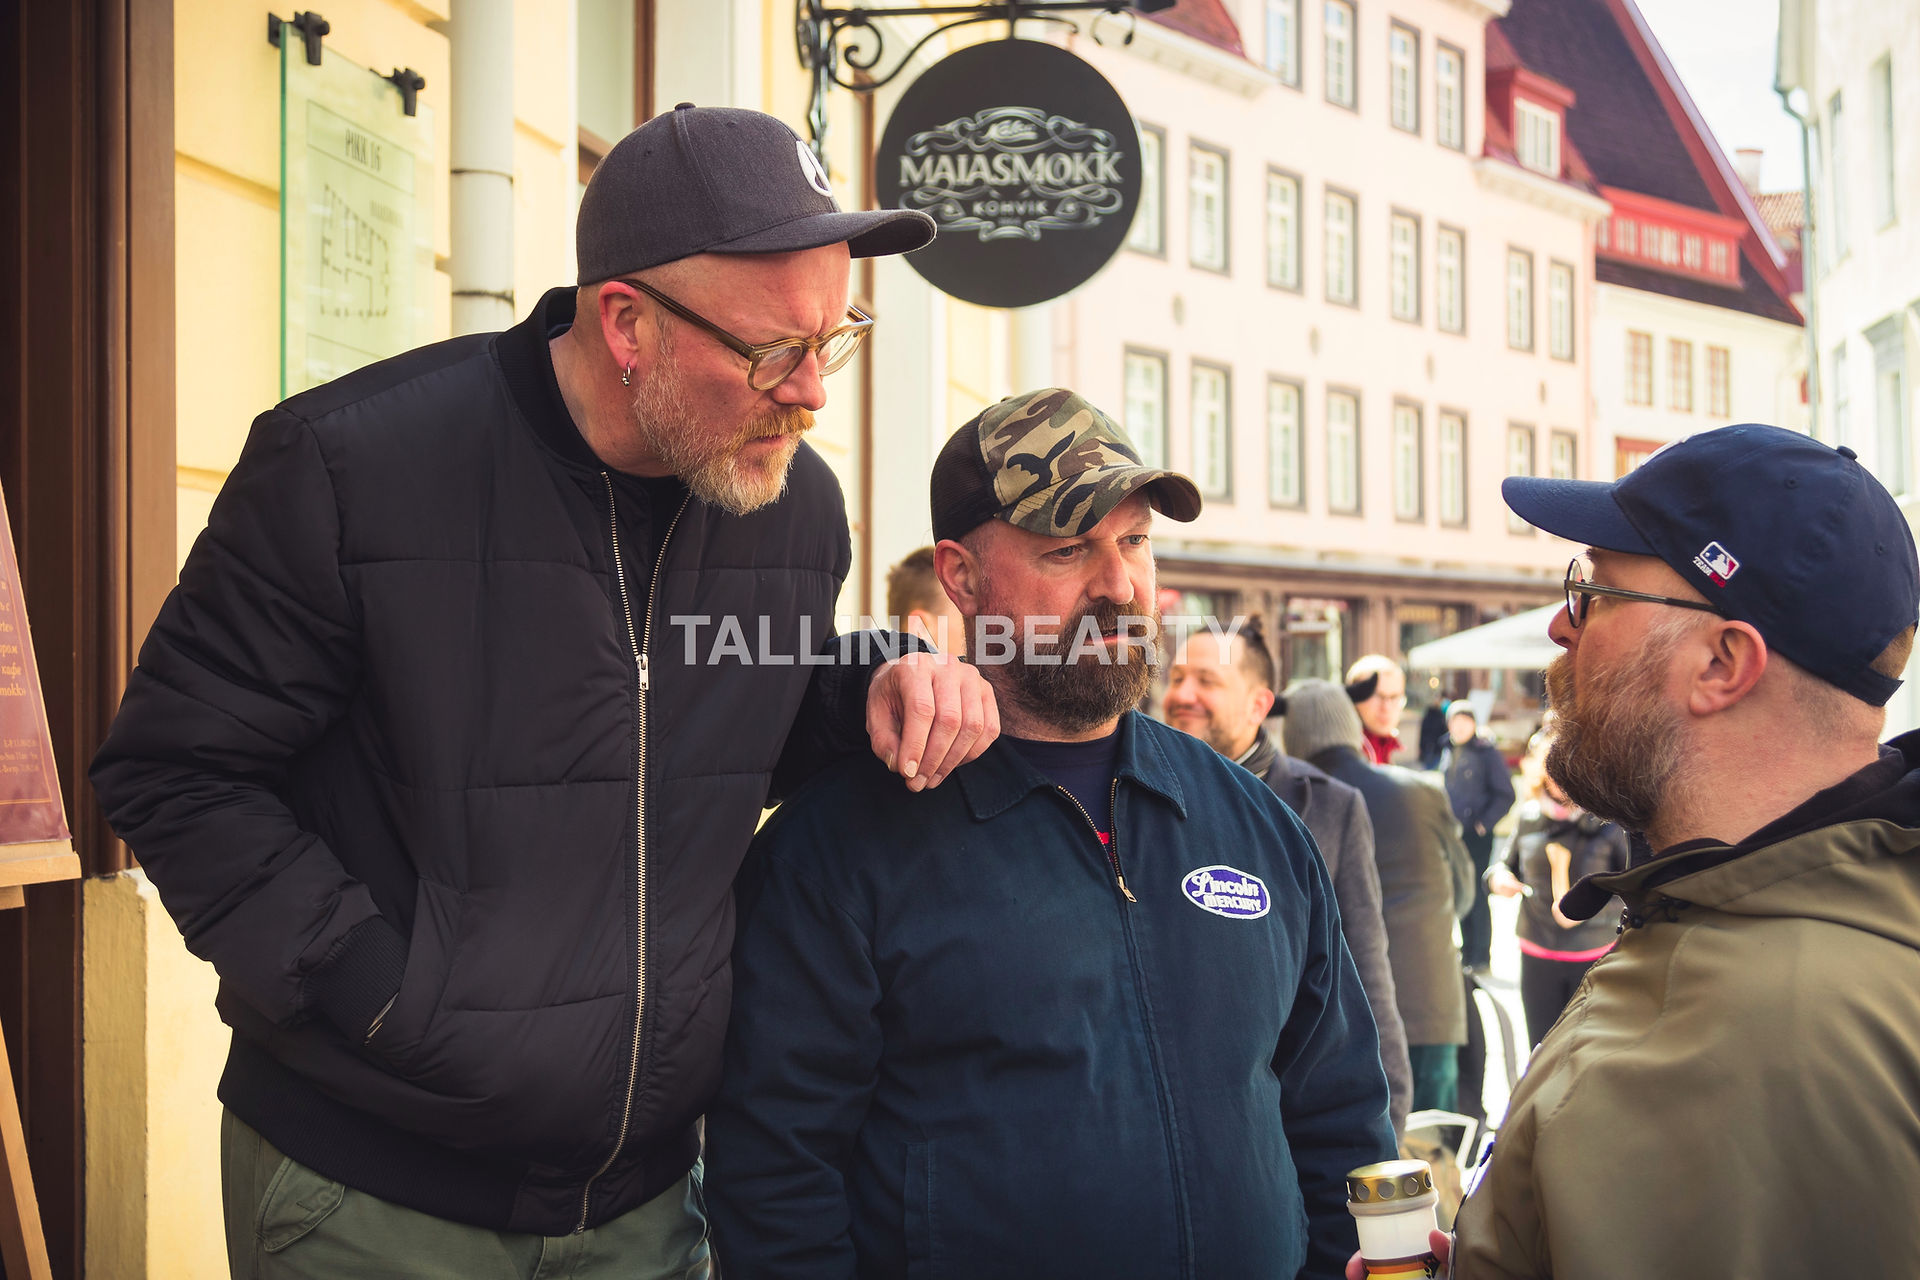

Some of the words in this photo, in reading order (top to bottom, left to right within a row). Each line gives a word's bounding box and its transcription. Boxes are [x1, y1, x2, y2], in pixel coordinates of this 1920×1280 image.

[899, 152, 1124, 187] MAIASMOKK
[973, 200, 1049, 217] KOHVIK
[1693, 556, 1713, 576] TEAM
[1191, 871, 1259, 897] Lincoln
[1203, 894, 1261, 911] MERCURY
